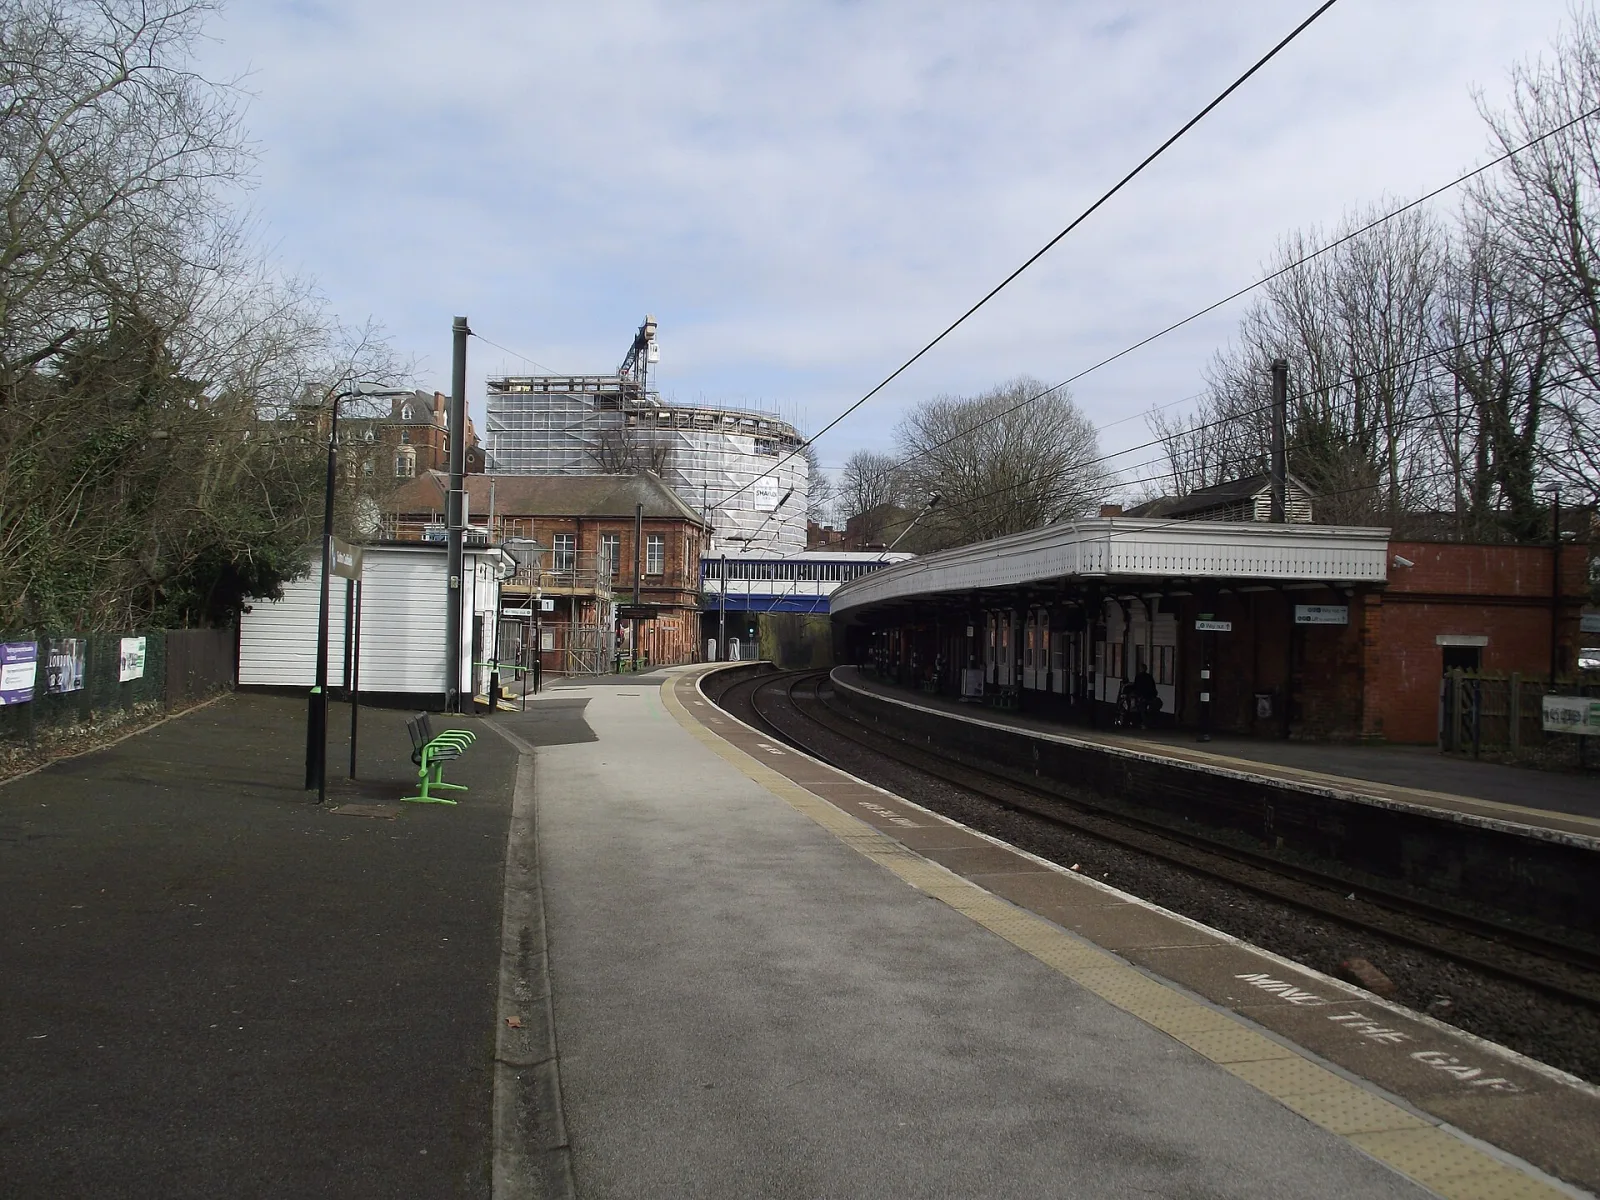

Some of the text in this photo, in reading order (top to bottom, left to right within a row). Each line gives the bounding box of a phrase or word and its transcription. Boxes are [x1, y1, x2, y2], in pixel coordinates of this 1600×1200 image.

[1234, 973, 1525, 1092] MIND THE GAP
